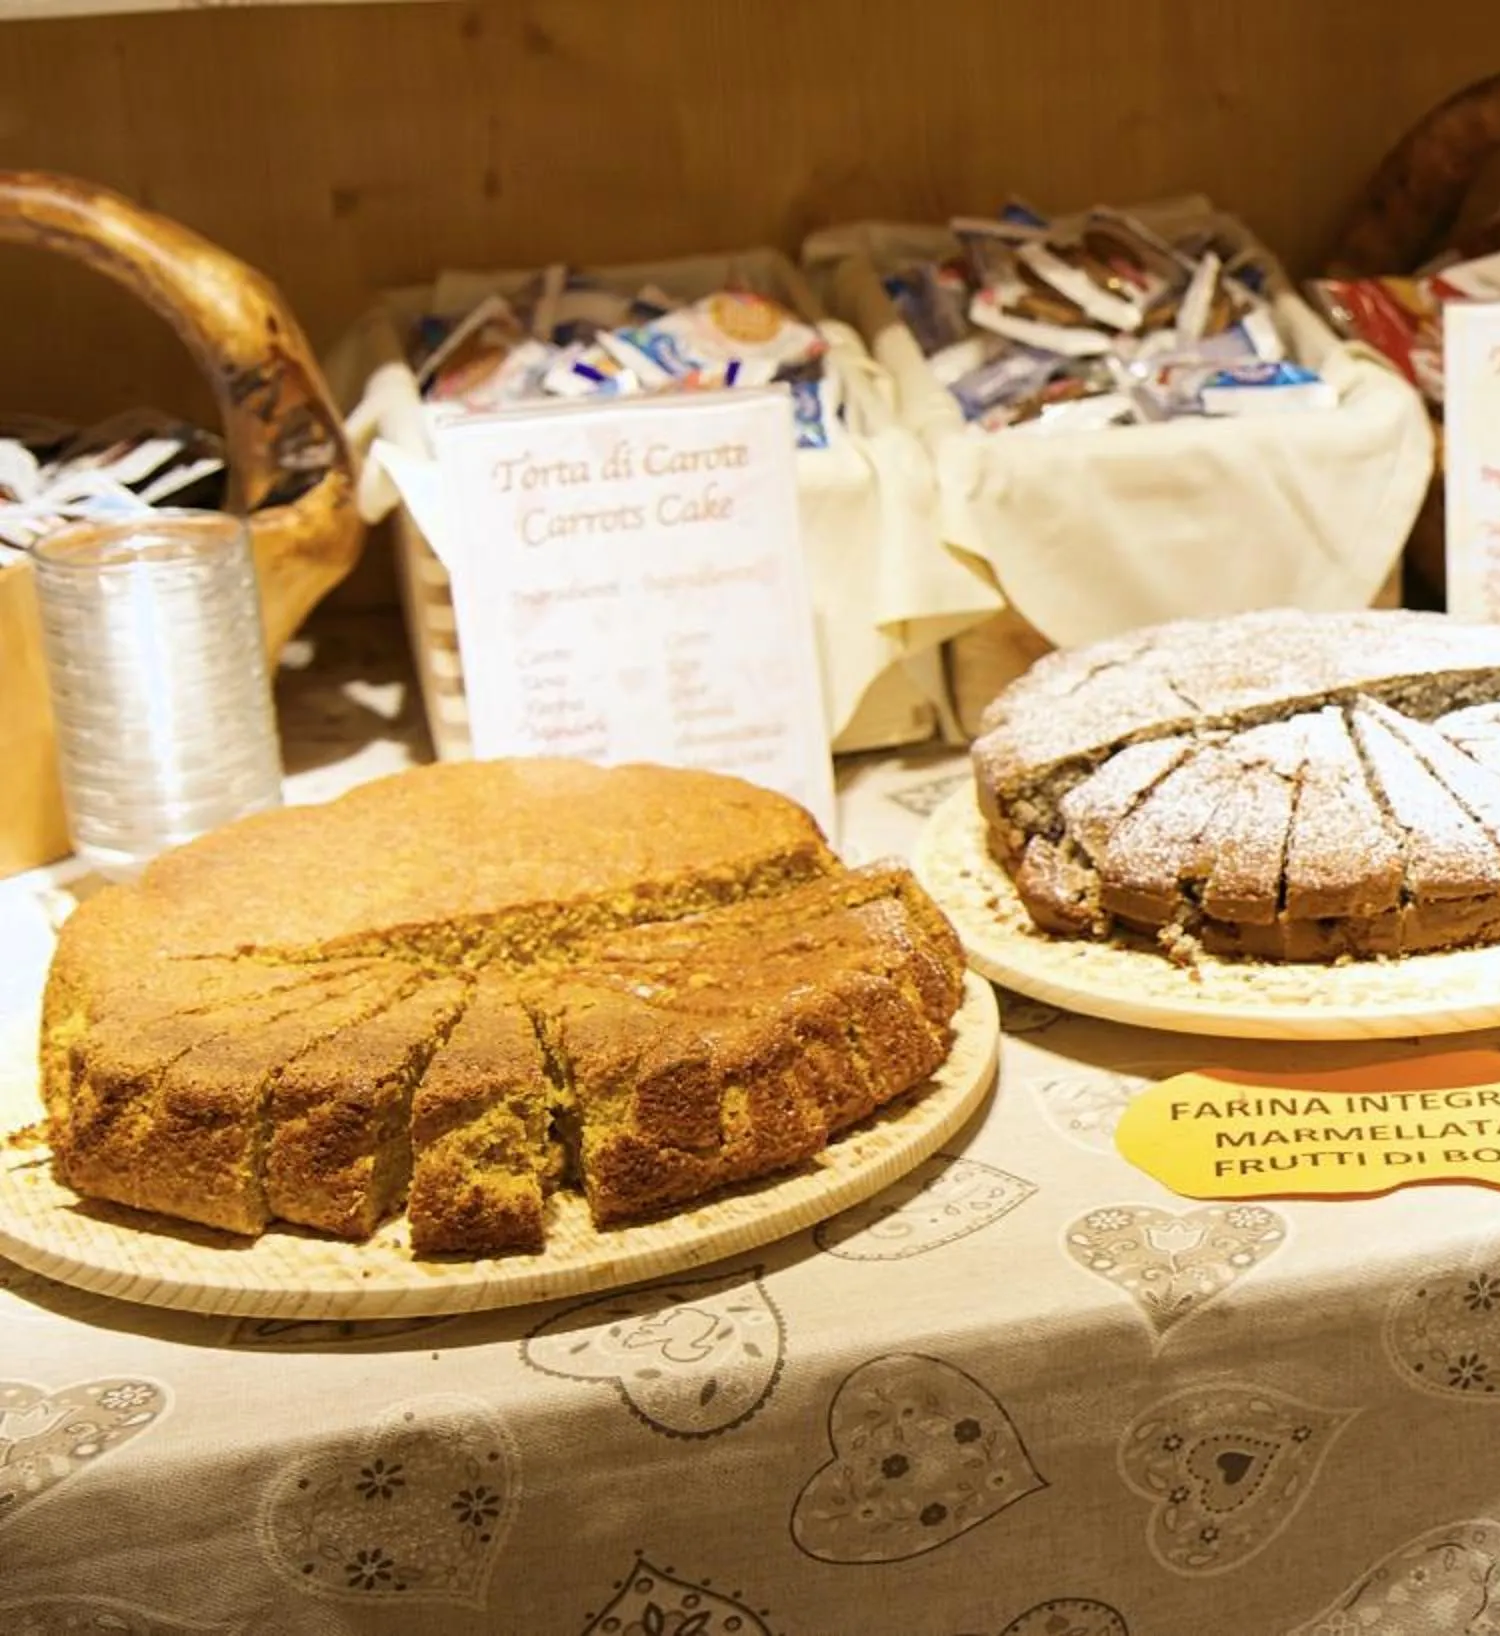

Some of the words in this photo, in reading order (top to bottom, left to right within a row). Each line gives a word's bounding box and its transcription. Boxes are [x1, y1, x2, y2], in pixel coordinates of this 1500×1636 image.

[491, 450, 590, 493] Torta
[602, 440, 632, 480] di
[643, 443, 748, 476] Carote
[520, 506, 645, 547] Carrots
[656, 481, 734, 527] Cake
[1170, 1095, 1331, 1122] FARINA
[1214, 1150, 1368, 1178] FRUTTI
[1383, 1150, 1426, 1166] DI
